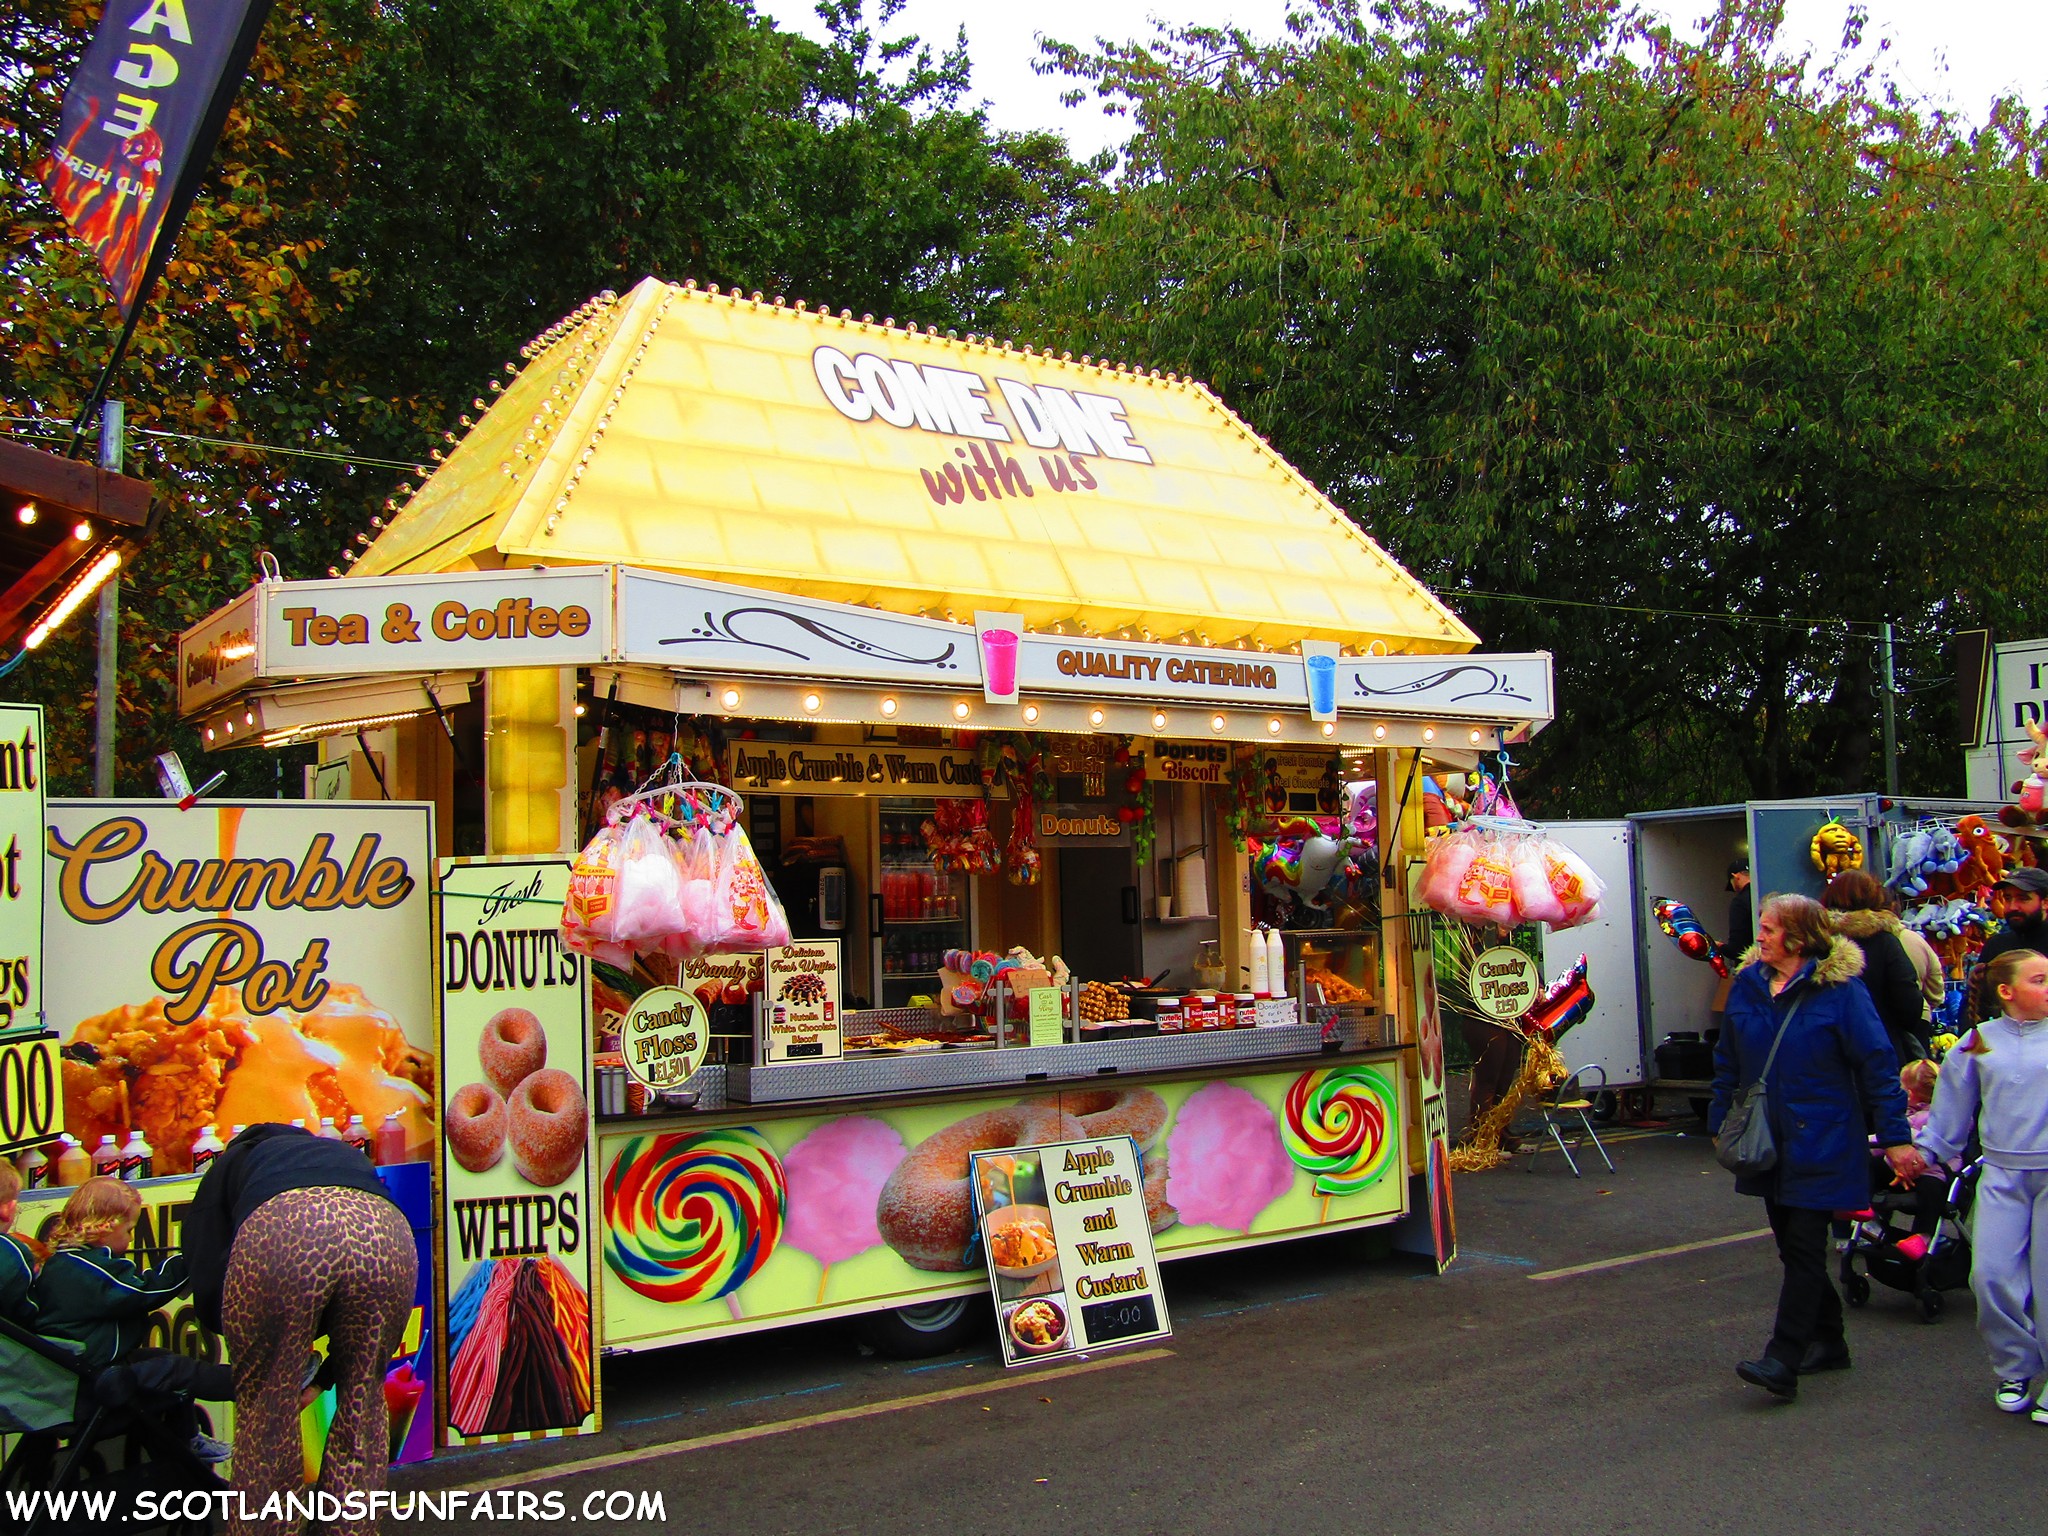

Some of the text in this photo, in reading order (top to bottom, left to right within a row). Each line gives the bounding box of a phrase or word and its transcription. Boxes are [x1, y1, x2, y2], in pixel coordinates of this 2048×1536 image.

[813, 346, 1154, 465] COME DINE
[920, 440, 1098, 506] with us
[283, 598, 591, 646] Tea & Coffee
[1057, 650, 1277, 689] QUALITY CATERING
[1154, 741, 1227, 762] Donuts
[735, 748, 786, 787] Apple
[789, 751, 864, 782] Crumble
[867, 754, 883, 783] &
[885, 754, 939, 784] Warm
[1161, 761, 1221, 781] Biscoff
[1041, 814, 1121, 836] Donuts
[47, 816, 416, 925] Crumble
[477, 869, 546, 926] Fresh
[446, 927, 578, 994] DONUTS
[782, 945, 826, 959] Delicious
[151, 919, 330, 1026] Pot
[685, 957, 747, 984] Brandy
[770, 959, 837, 975] Fresh Waffles
[1478, 959, 1526, 977] Candy
[1480, 981, 1530, 1000] Floss
[633, 1002, 694, 1033] Candy
[790, 1012, 819, 1022] Nutella
[1159, 1014, 1182, 1022] nutella
[1495, 1000, 1518, 1014] £1.50
[771, 1023, 838, 1034] White Chocolate
[634, 1032, 698, 1064] Floss
[654, 1058, 685, 1083] £1.50
[1063, 1146, 1115, 1176] Apple
[1055, 1175, 1133, 1204] Crumble
[453, 1191, 580, 1261] WHIPS
[1083, 1207, 1117, 1232] and
[1076, 1240, 1134, 1266] Warm
[1076, 1267, 1148, 1300] Custard
